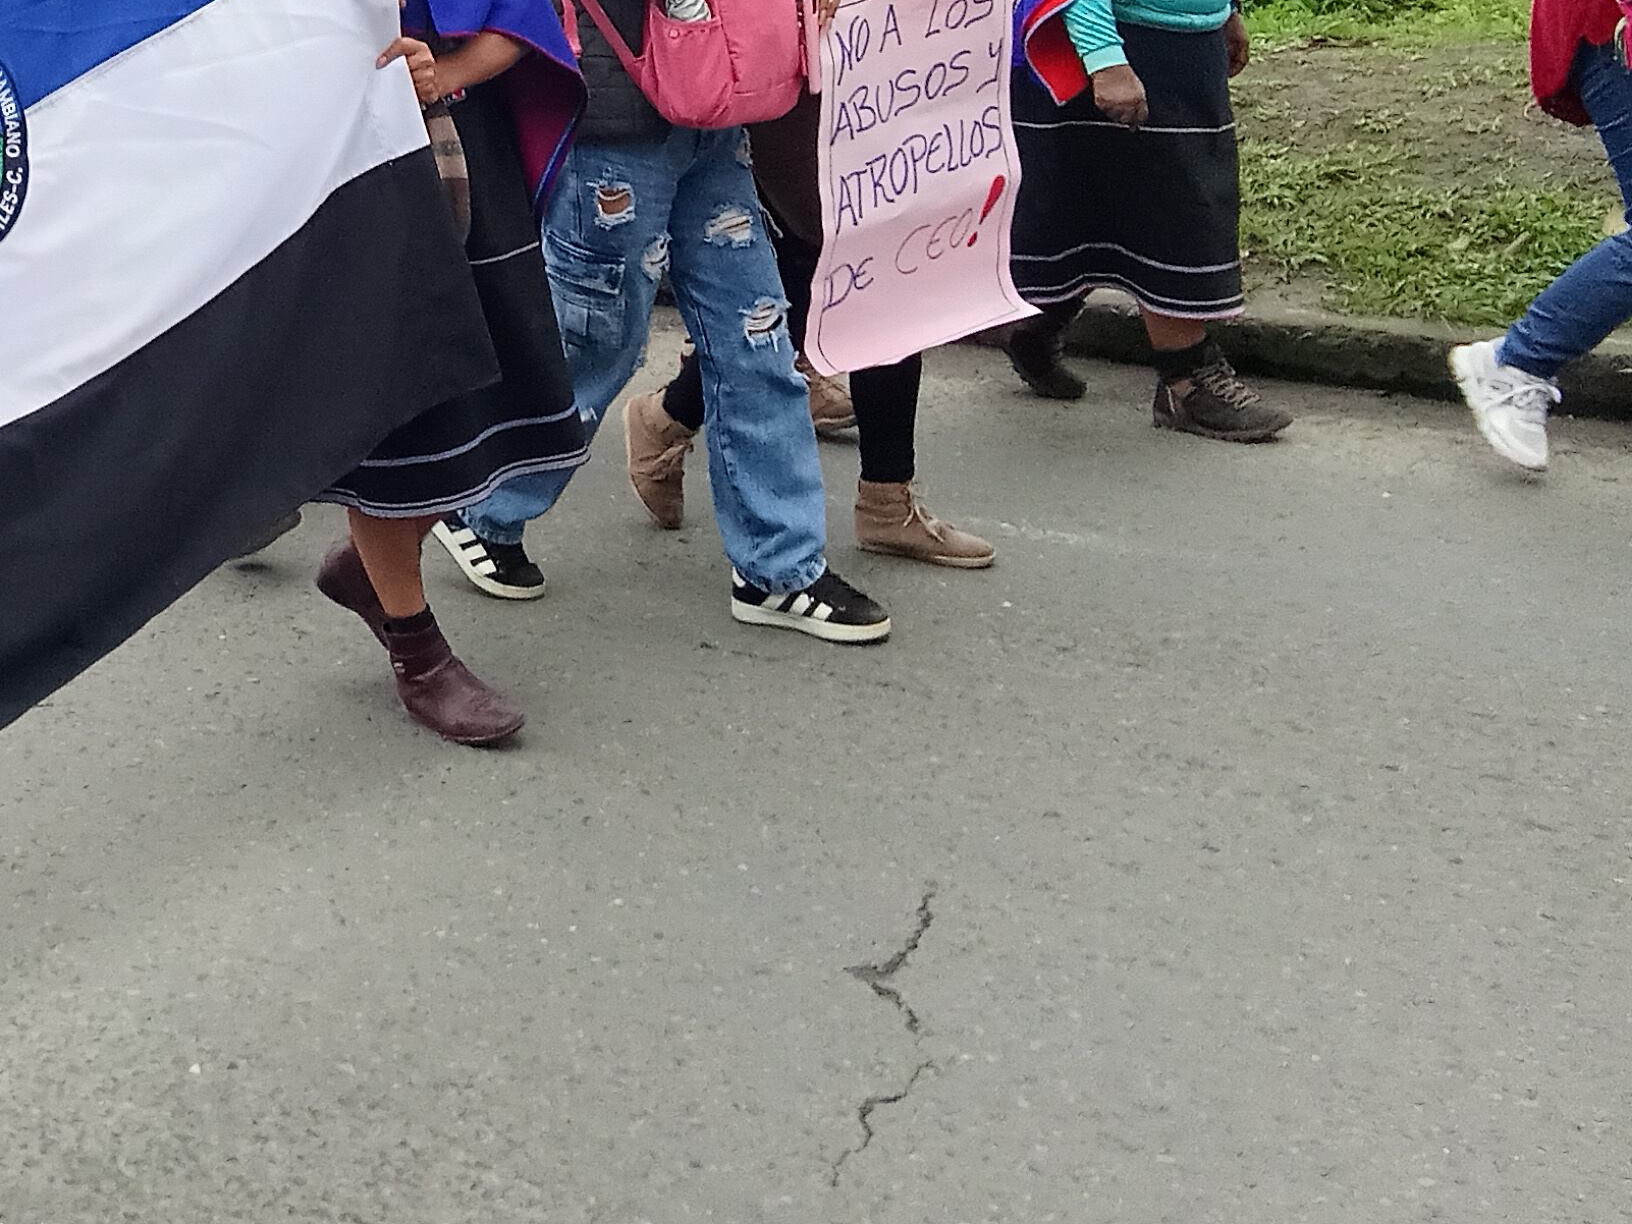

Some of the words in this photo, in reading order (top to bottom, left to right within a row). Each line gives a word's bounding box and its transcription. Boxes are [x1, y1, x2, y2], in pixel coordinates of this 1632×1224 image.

[836, 14, 870, 86] NO
[879, 4, 904, 53] A
[830, 50, 972, 147] ABUSOS
[836, 105, 1004, 235] ATROPELLOS
[821, 256, 874, 313] DE
